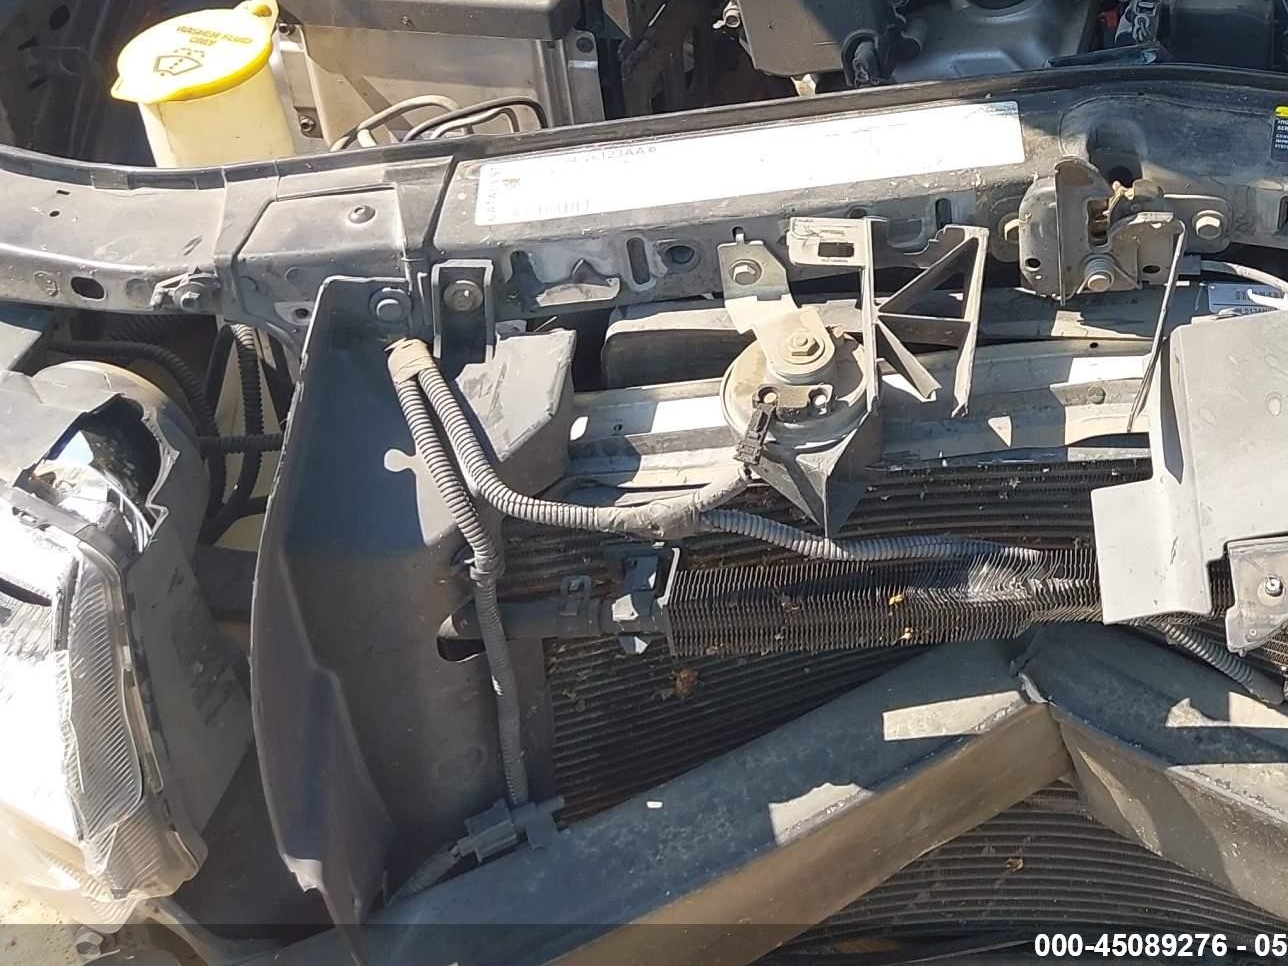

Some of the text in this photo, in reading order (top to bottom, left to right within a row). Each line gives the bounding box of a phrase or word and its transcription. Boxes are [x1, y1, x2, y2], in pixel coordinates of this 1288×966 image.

[177, 25, 253, 44] WASHER FLUID
[189, 36, 217, 46] ONLY
